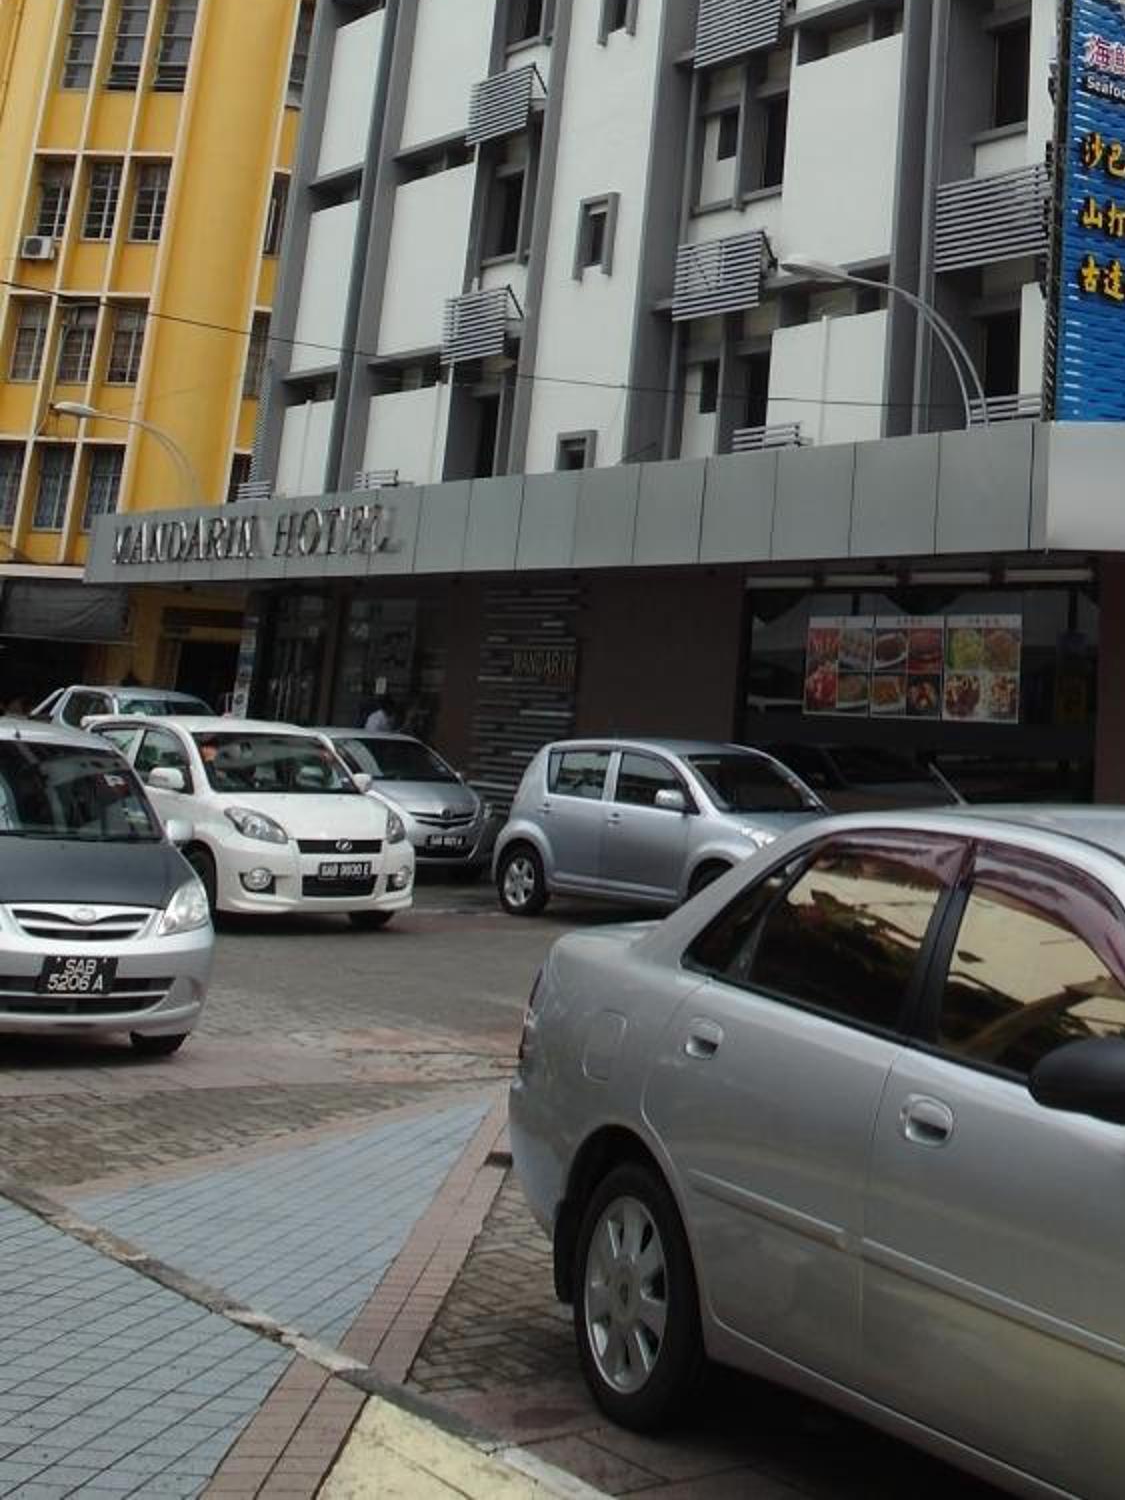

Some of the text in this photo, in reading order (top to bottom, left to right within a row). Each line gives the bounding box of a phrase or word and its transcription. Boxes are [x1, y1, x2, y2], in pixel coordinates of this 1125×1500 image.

[111, 503, 398, 564] MANDARIN HOTEL
[64, 959, 97, 975] SAB
[47, 973, 103, 992] 5206 A
